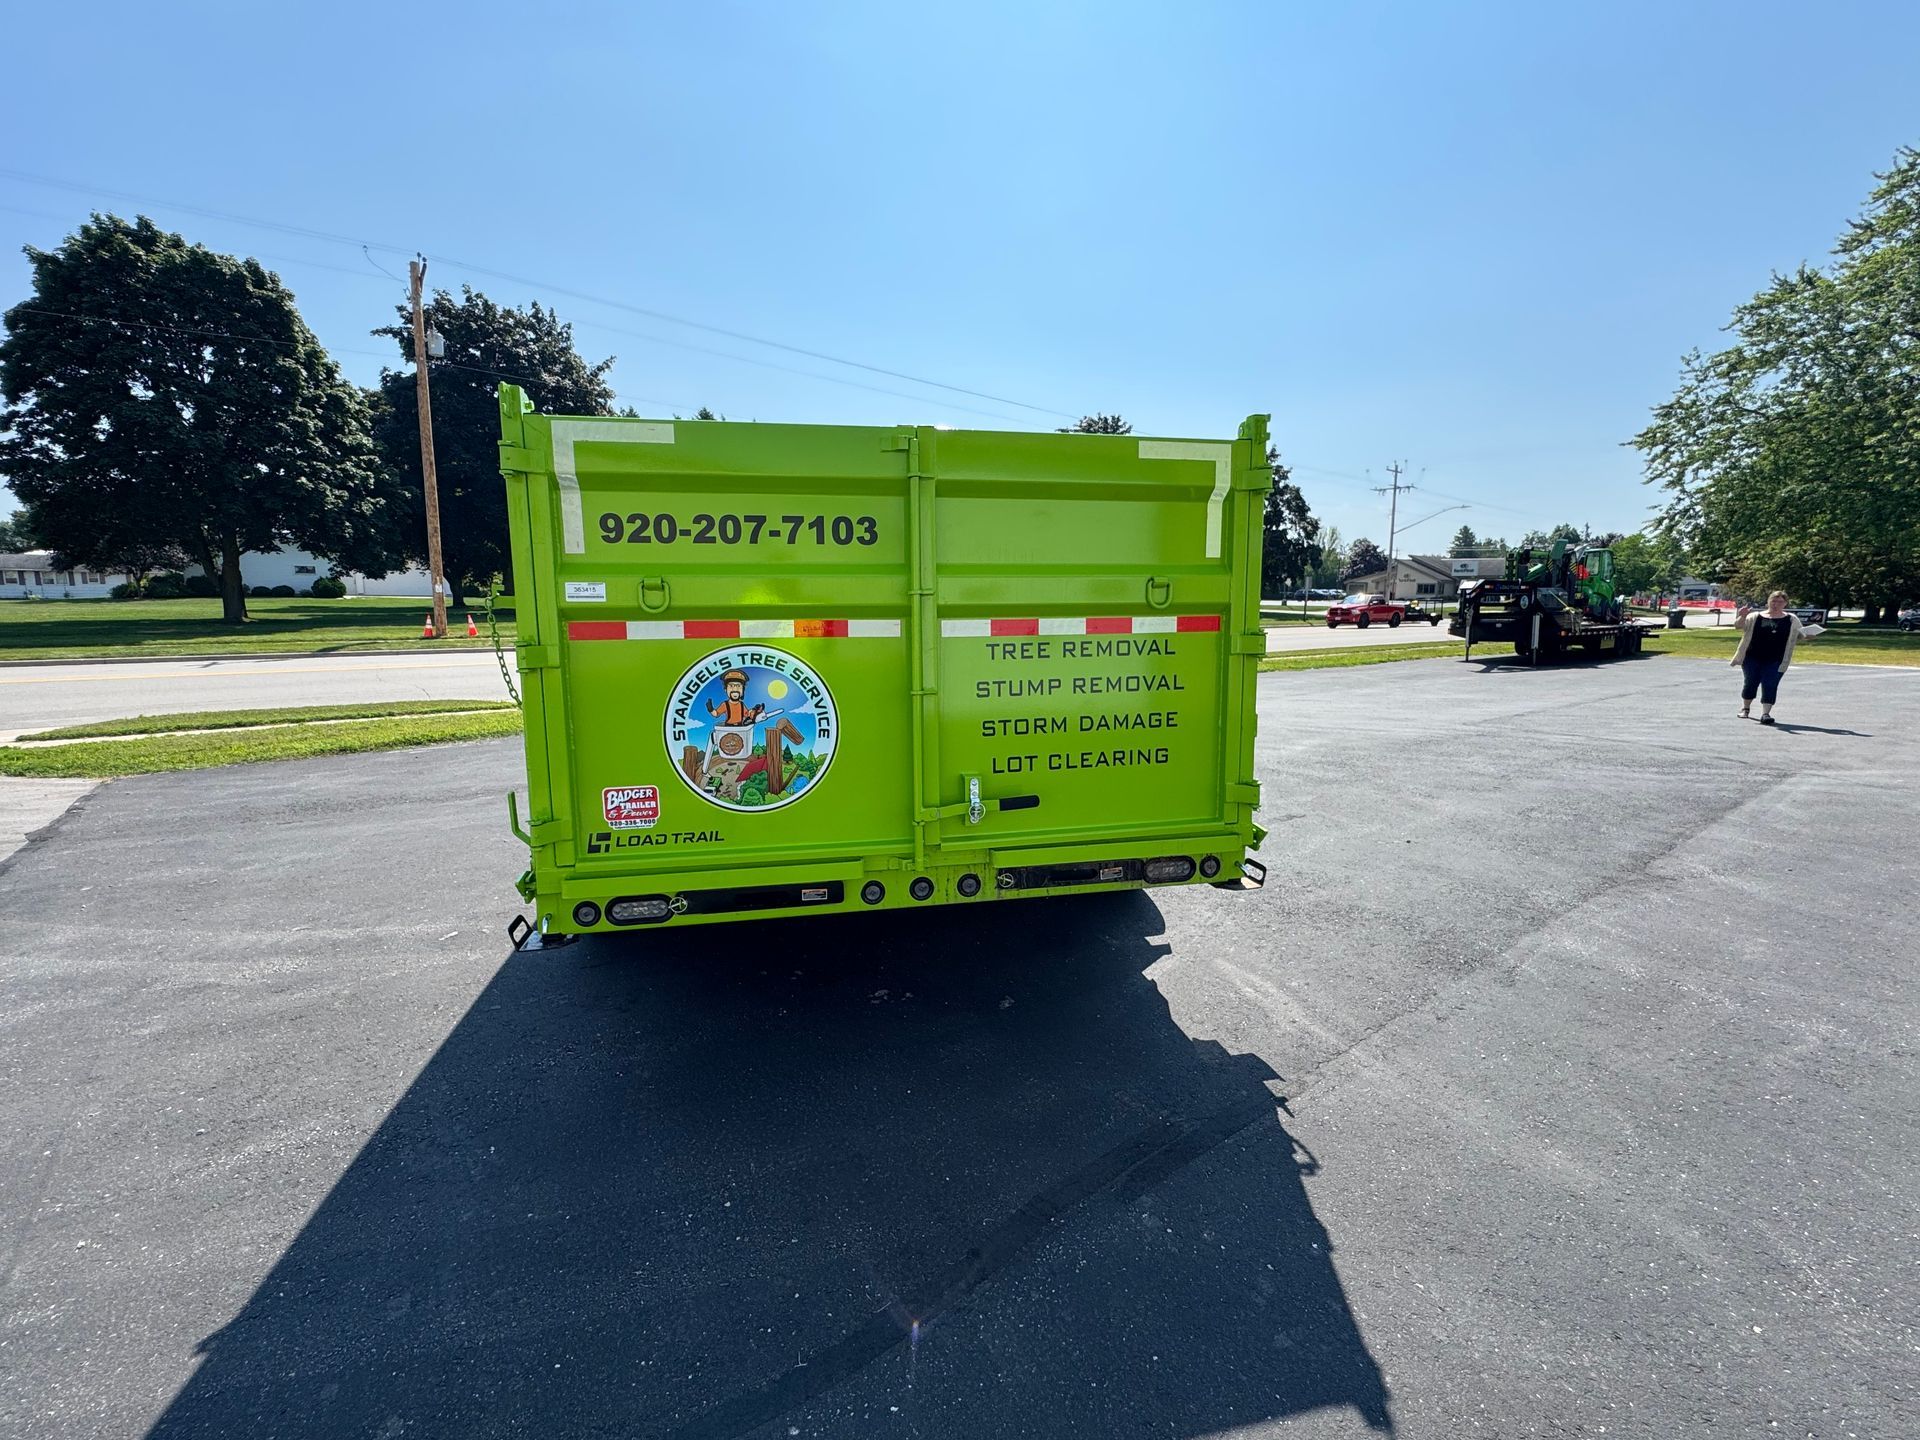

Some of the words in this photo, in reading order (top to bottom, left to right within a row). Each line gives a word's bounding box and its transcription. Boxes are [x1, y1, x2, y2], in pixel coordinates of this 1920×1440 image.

[599, 512, 879, 545] 920-207-7103
[986, 642, 1050, 660] TREE
[1062, 639, 1176, 658] REMOVAL
[673, 656, 732, 742] STANGEL'S
[737, 652, 788, 672] TREE
[789, 668, 831, 739] SERVICE
[976, 678, 1061, 698] STUMP
[1072, 674, 1185, 694] REMOVAL
[982, 716, 1067, 737] STORM
[1079, 711, 1178, 732] DAMAGE
[992, 755, 1038, 774] LOT
[1048, 747, 1169, 770] CLEARING
[606, 789, 654, 810] BADGER
[620, 801, 656, 809] TRAILER
[616, 833, 667, 848] LOAD
[672, 831, 725, 844] TRAIL
